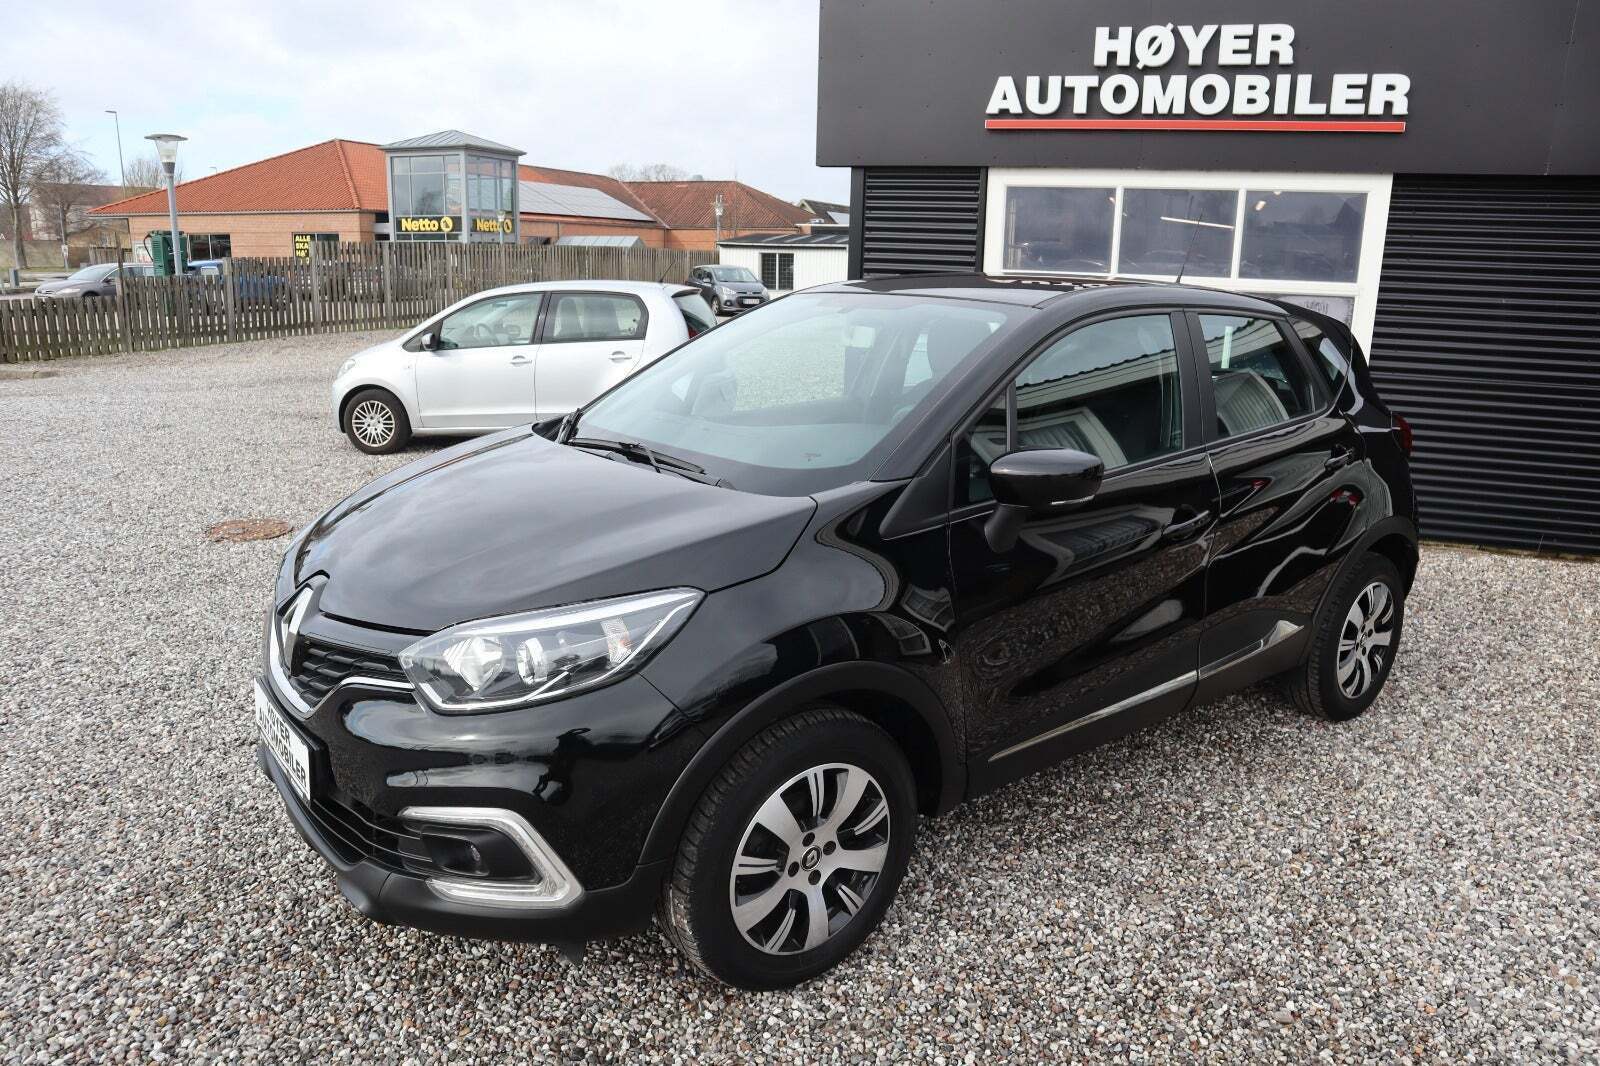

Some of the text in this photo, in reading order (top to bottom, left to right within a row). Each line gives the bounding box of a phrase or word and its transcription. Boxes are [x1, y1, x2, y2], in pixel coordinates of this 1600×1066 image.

[1093, 22, 1295, 70] HØYER
[985, 74, 1411, 116] AUTOMOBILER
[401, 218, 439, 232] Netto
